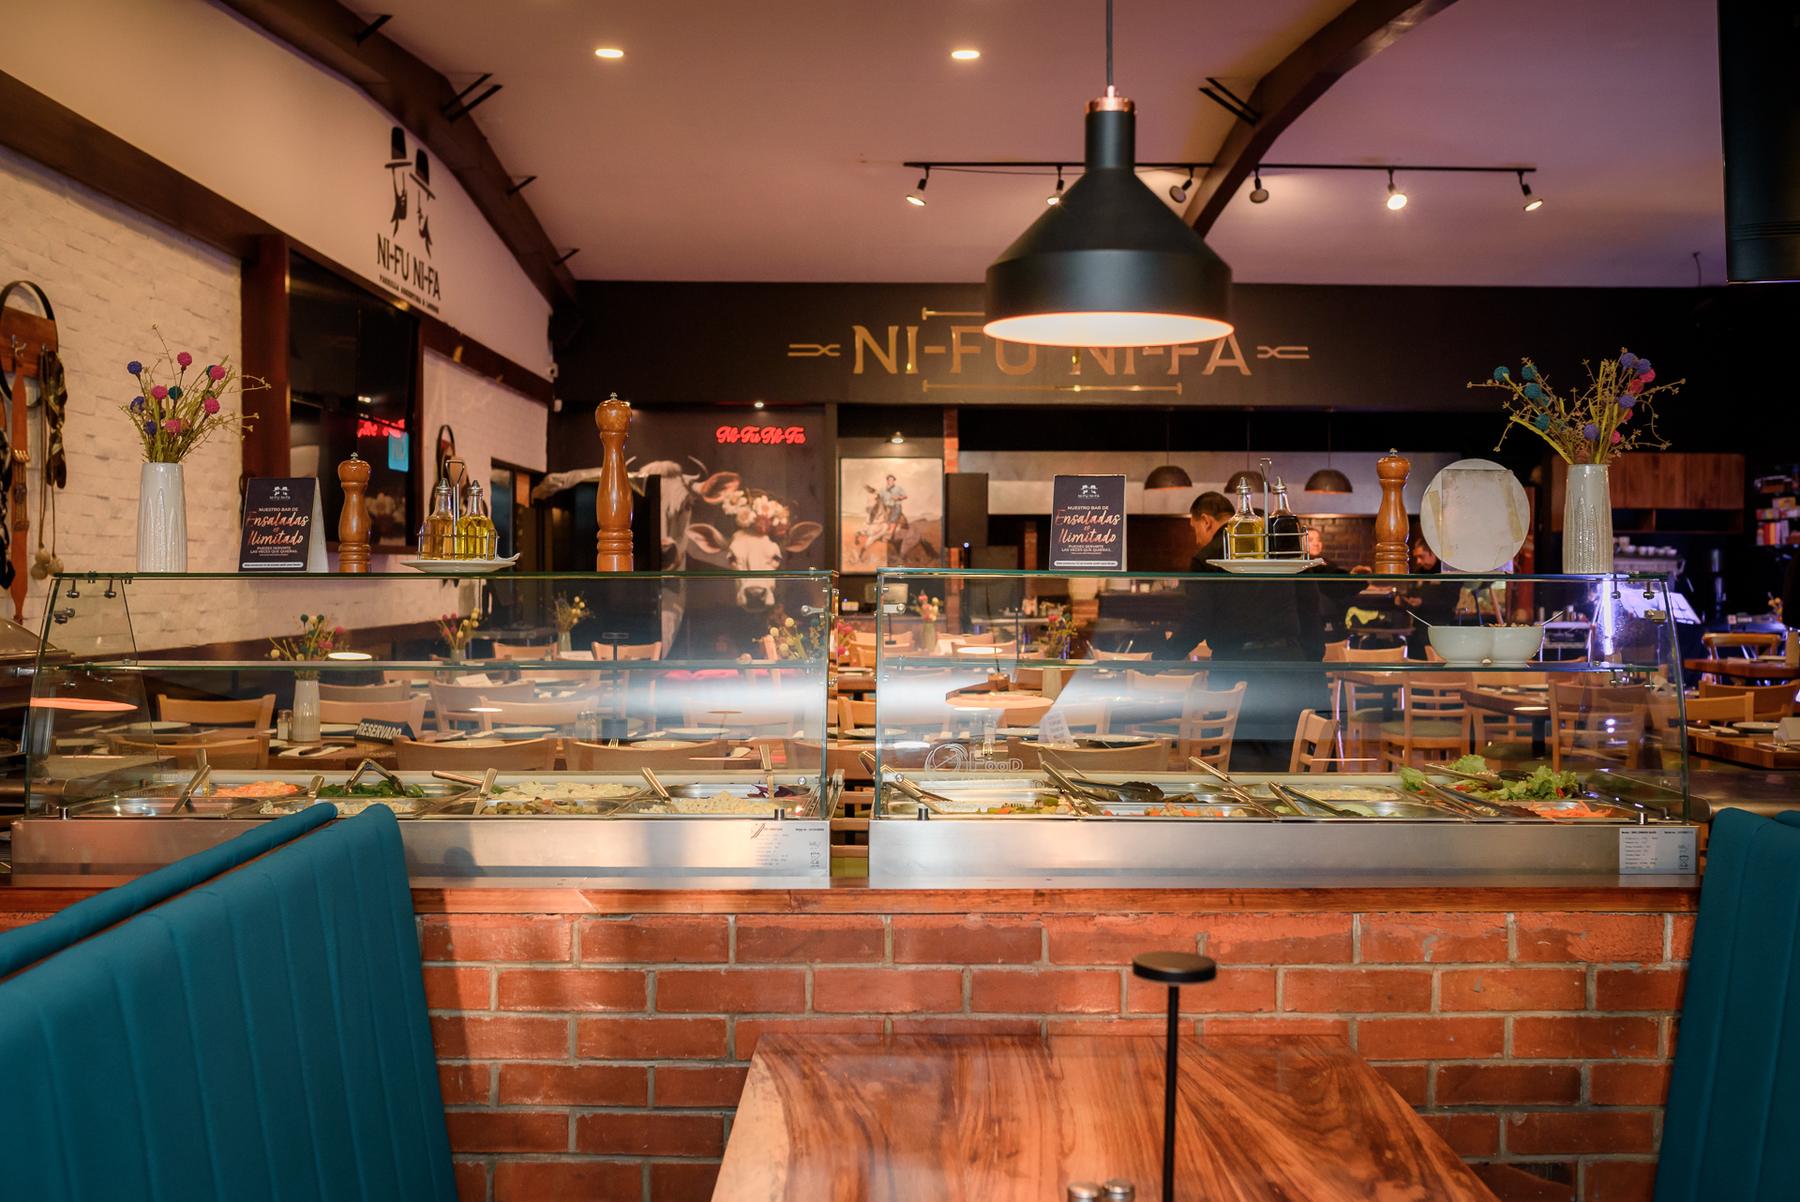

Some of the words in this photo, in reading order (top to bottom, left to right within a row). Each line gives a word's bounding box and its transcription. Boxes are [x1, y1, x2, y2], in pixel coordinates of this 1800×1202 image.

[377, 232, 410, 281] NI-FU
[413, 256, 441, 301] NI-FA
[852, 325, 1038, 375] NI-FU
[246, 511, 310, 528] Ensaladas
[1055, 509, 1121, 526] Ensaladas
[247, 530, 304, 546] Ilimitado
[1058, 528, 1117, 545] Ilimitado
[356, 722, 402, 740] RESERVADO
